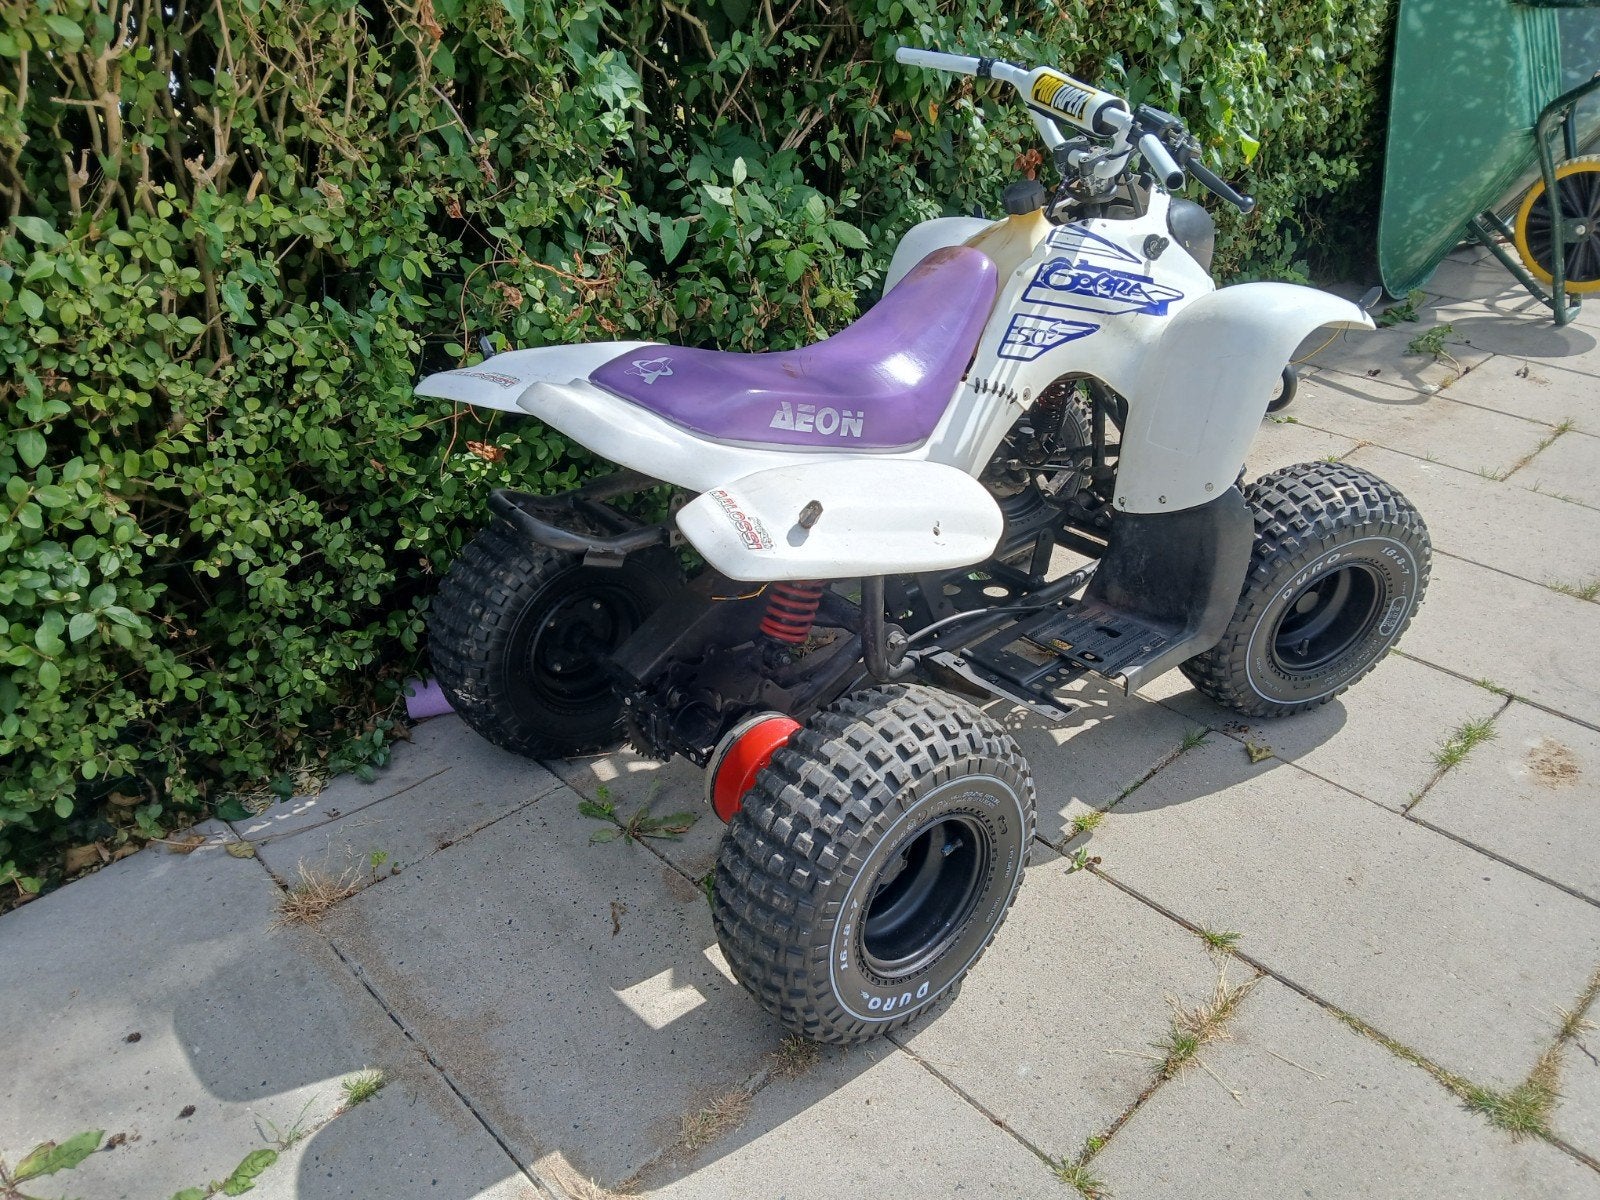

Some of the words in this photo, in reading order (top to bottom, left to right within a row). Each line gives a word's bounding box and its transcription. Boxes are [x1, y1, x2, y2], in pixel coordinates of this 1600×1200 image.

[769, 401, 864, 437] AEON
[1281, 553, 1341, 600] DURO
[867, 981, 930, 1012] DURO
